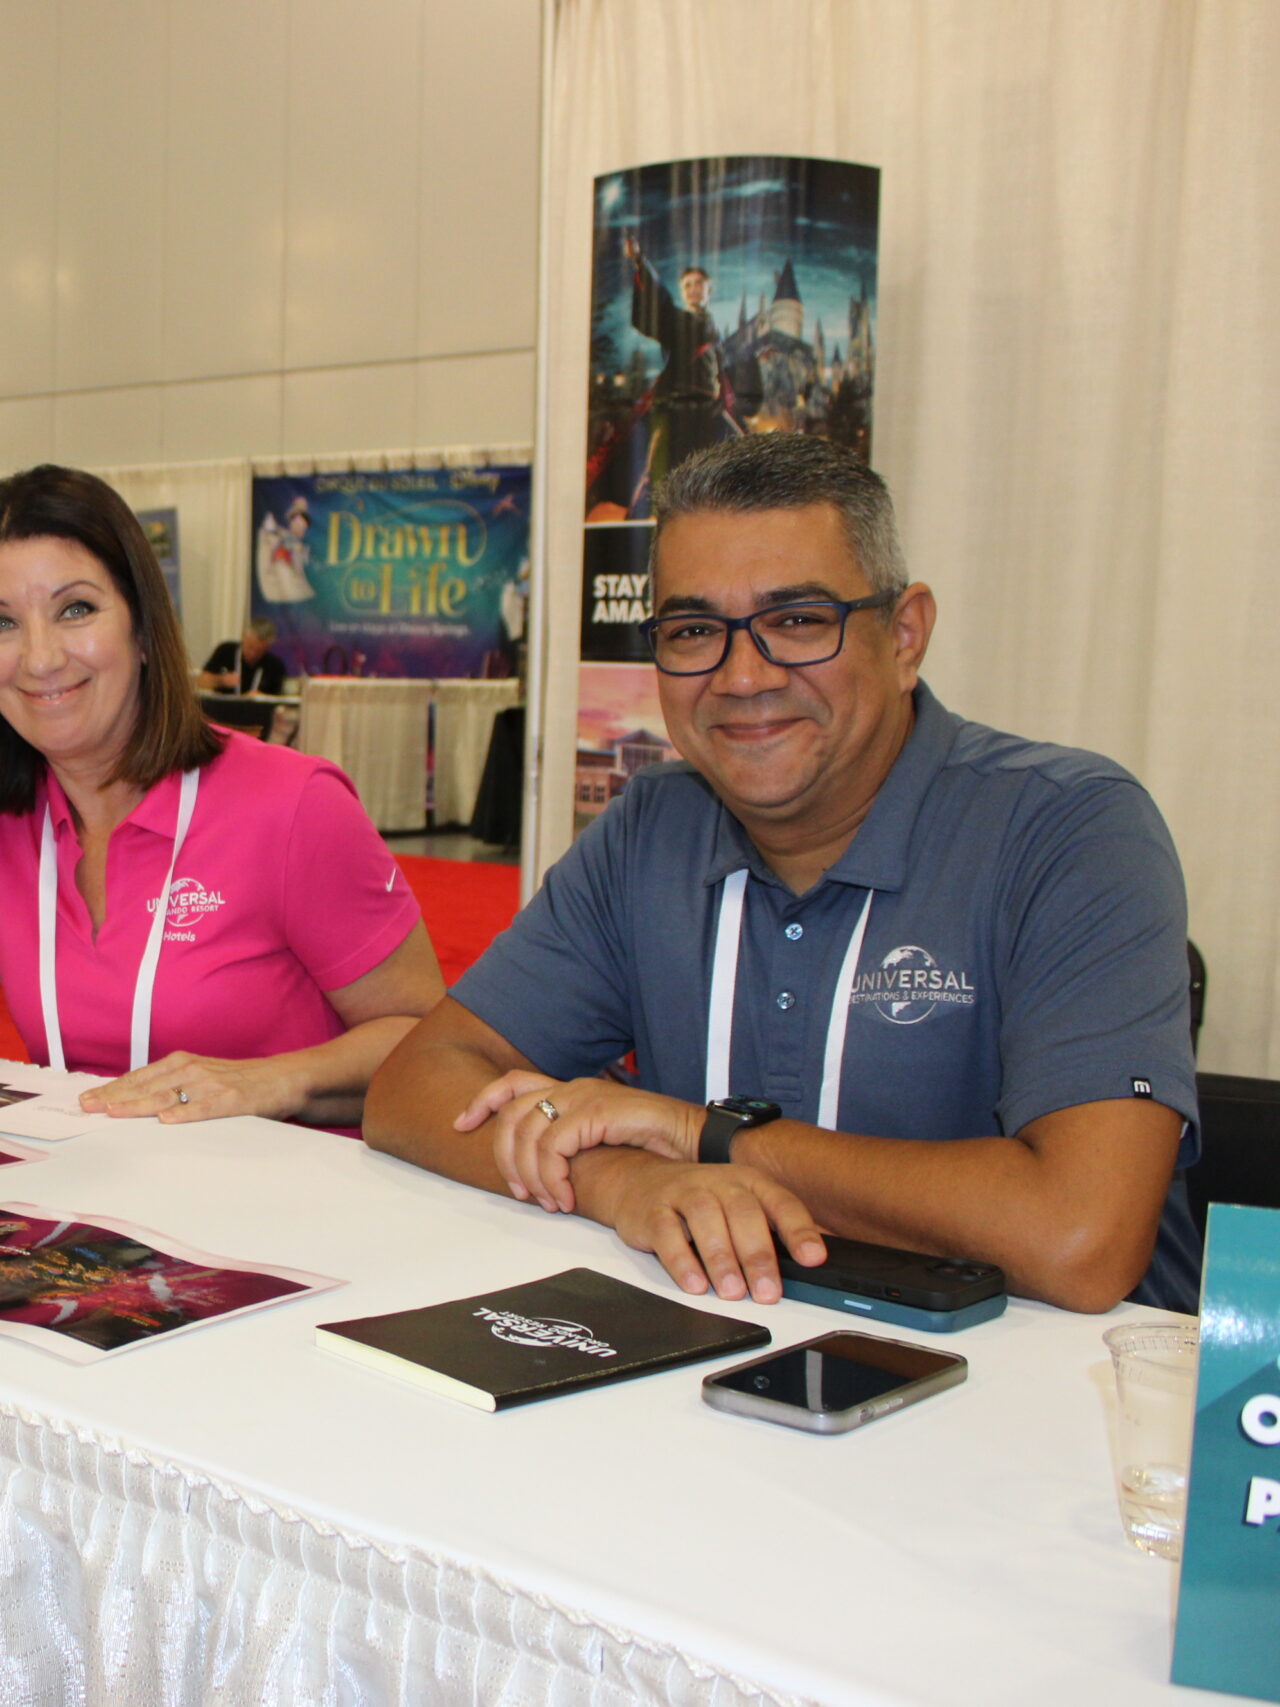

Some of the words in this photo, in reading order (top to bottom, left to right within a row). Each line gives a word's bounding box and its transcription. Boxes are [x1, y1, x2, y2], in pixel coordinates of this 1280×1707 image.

[327, 508, 484, 566] Drawn
[379, 560, 468, 618] Life
[593, 573, 649, 598] STAY
[164, 930, 196, 942] Hotels
[851, 970, 975, 993] UNIVERSAL
[850, 991, 900, 1004] ESTINATIONS
[911, 991, 975, 1004] EXPERIENCES
[499, 1311, 548, 1328] RESORT
[472, 1307, 617, 1357] UNIVERSAL
[548, 1327, 610, 1348] ORLANDO
